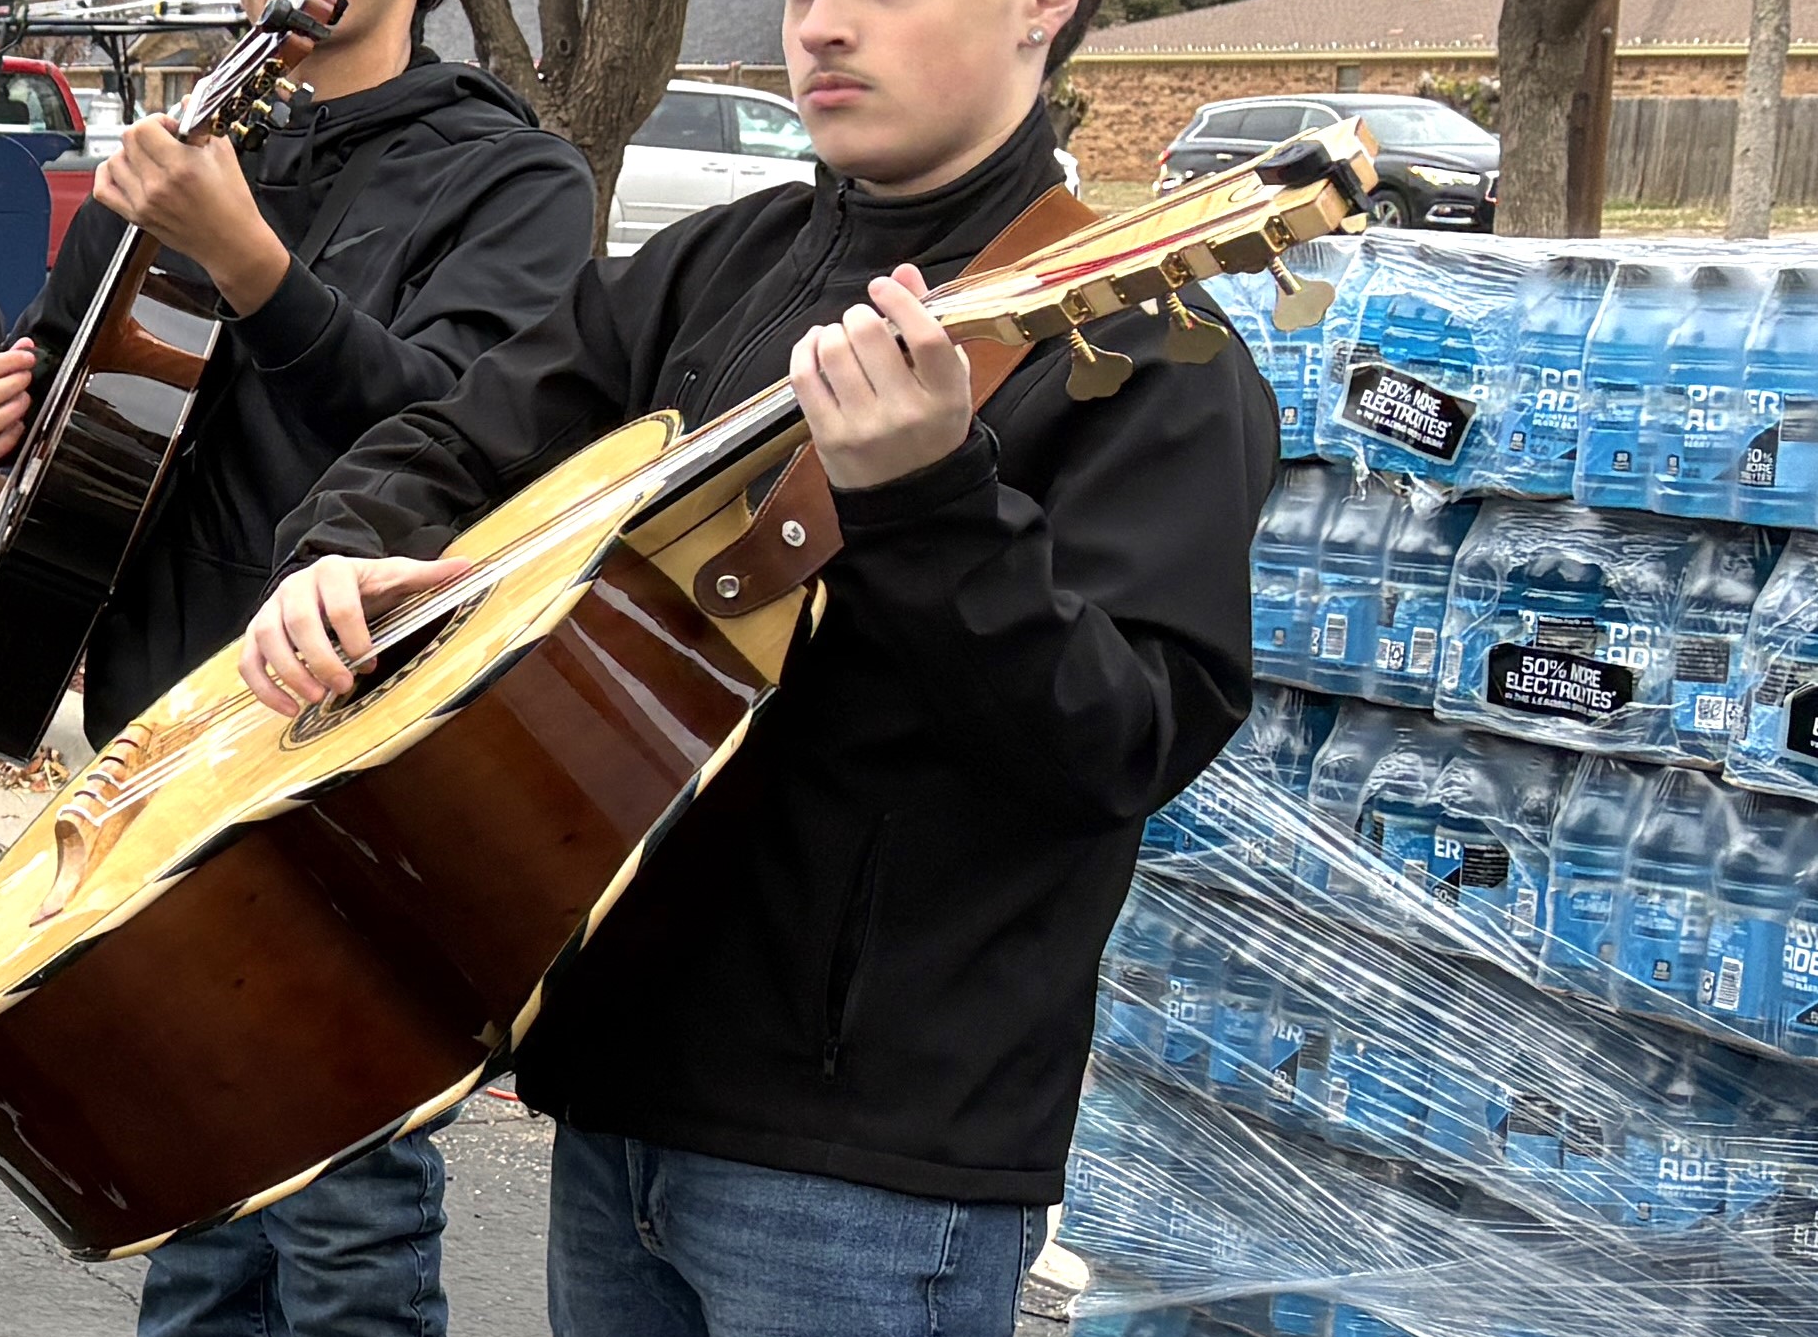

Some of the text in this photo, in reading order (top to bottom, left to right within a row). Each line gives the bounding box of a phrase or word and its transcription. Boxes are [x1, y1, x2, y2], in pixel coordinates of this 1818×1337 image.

[1377, 376, 1414, 403] 50%
[1360, 389, 1448, 439] ELECTROTES
[1521, 655, 1602, 689] 50% MORE
[1505, 671, 1612, 710] ELECTROTES
